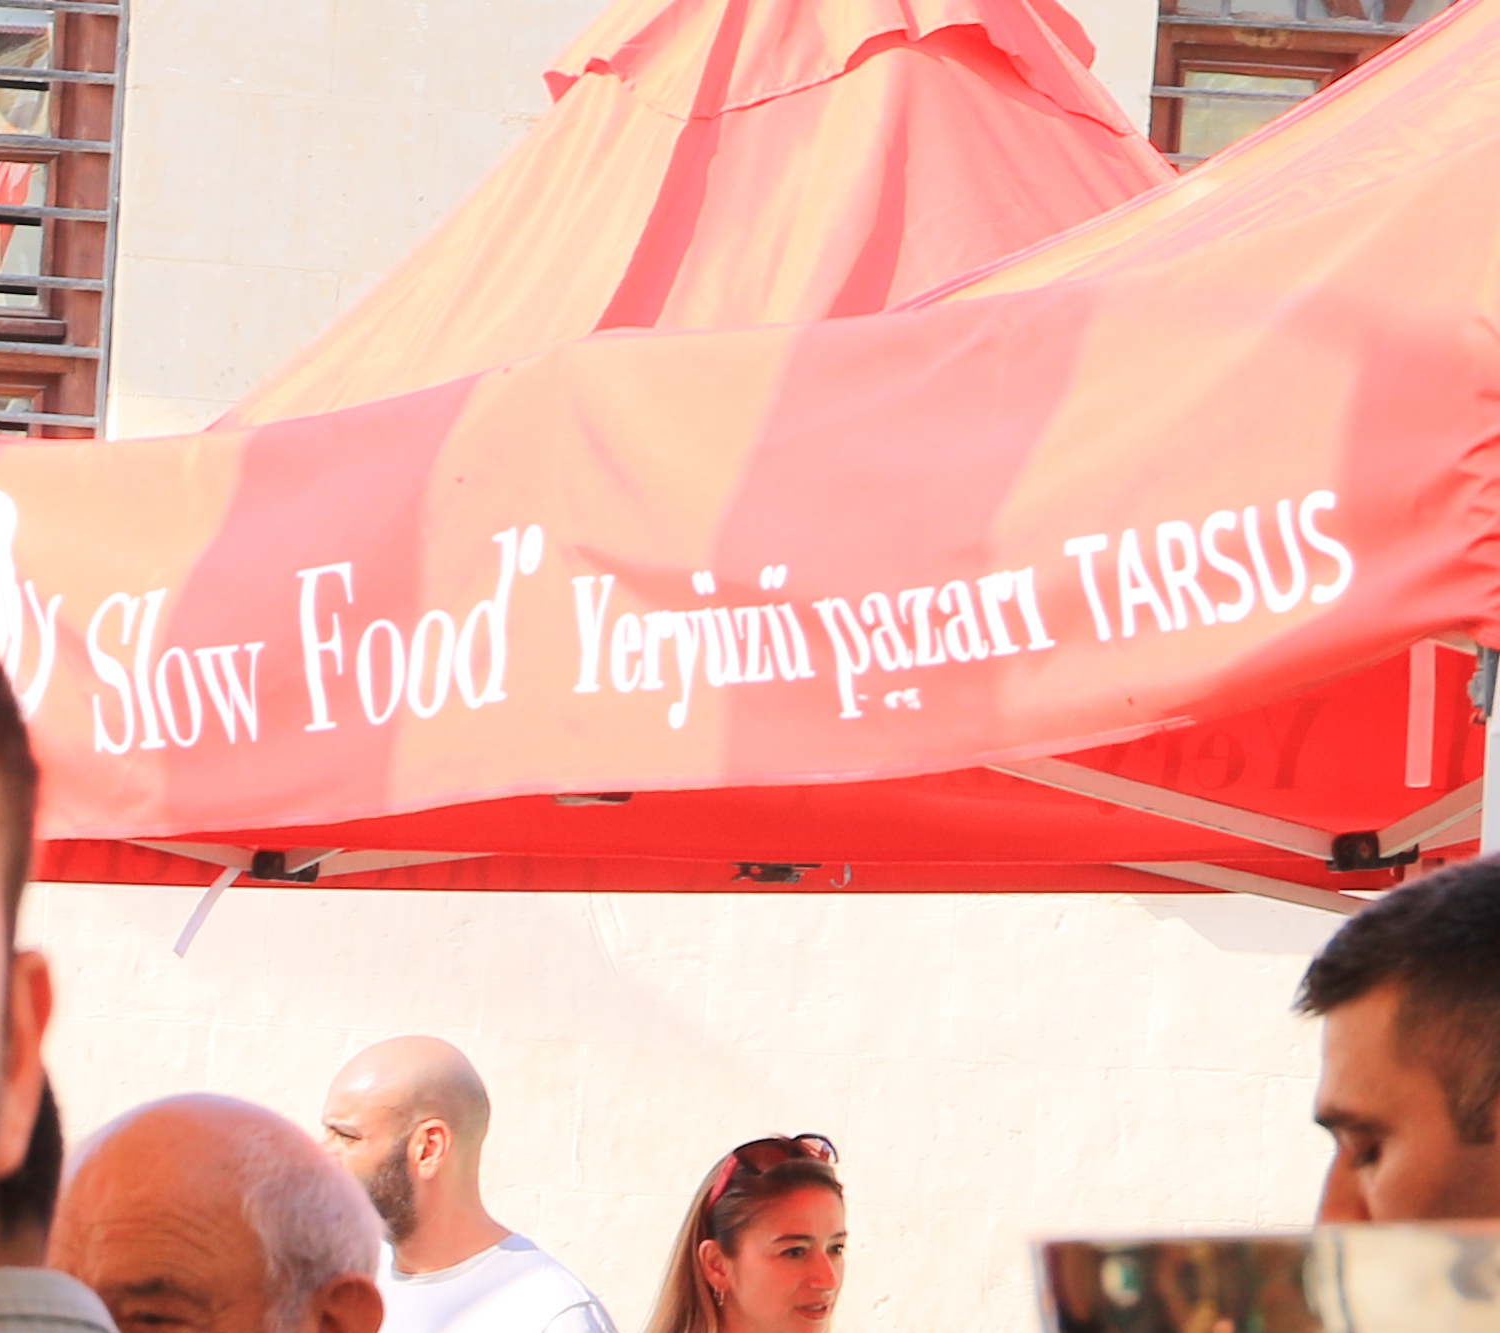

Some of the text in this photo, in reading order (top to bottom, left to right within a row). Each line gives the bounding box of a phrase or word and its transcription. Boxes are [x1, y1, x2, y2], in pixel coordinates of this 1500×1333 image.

[87, 587, 264, 755] Slow
[572, 565, 815, 729] Yeryüzü
[814, 566, 1055, 719] pazarı
[1065, 490, 1353, 641] TARSUS
